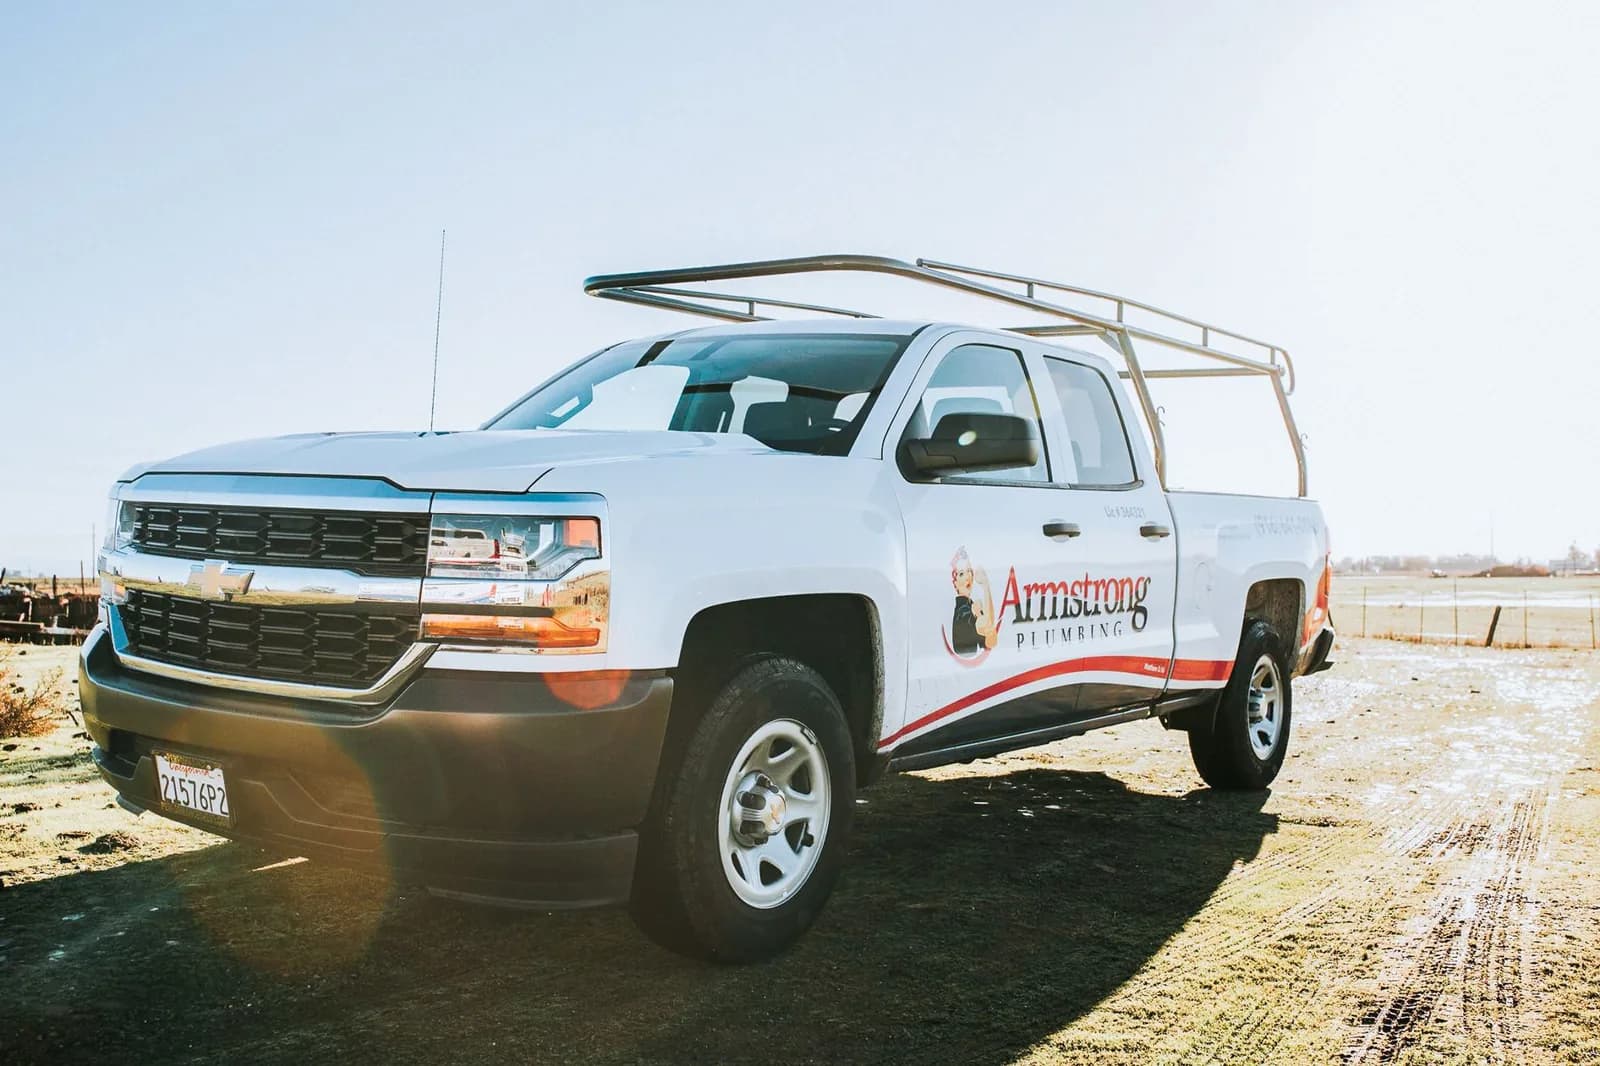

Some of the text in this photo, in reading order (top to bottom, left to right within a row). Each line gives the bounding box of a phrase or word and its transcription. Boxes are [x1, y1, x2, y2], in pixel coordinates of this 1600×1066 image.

[995, 565, 1152, 633] Armstrong
[1016, 620, 1122, 651] PLUMBING
[161, 773, 229, 815] 21576P2
